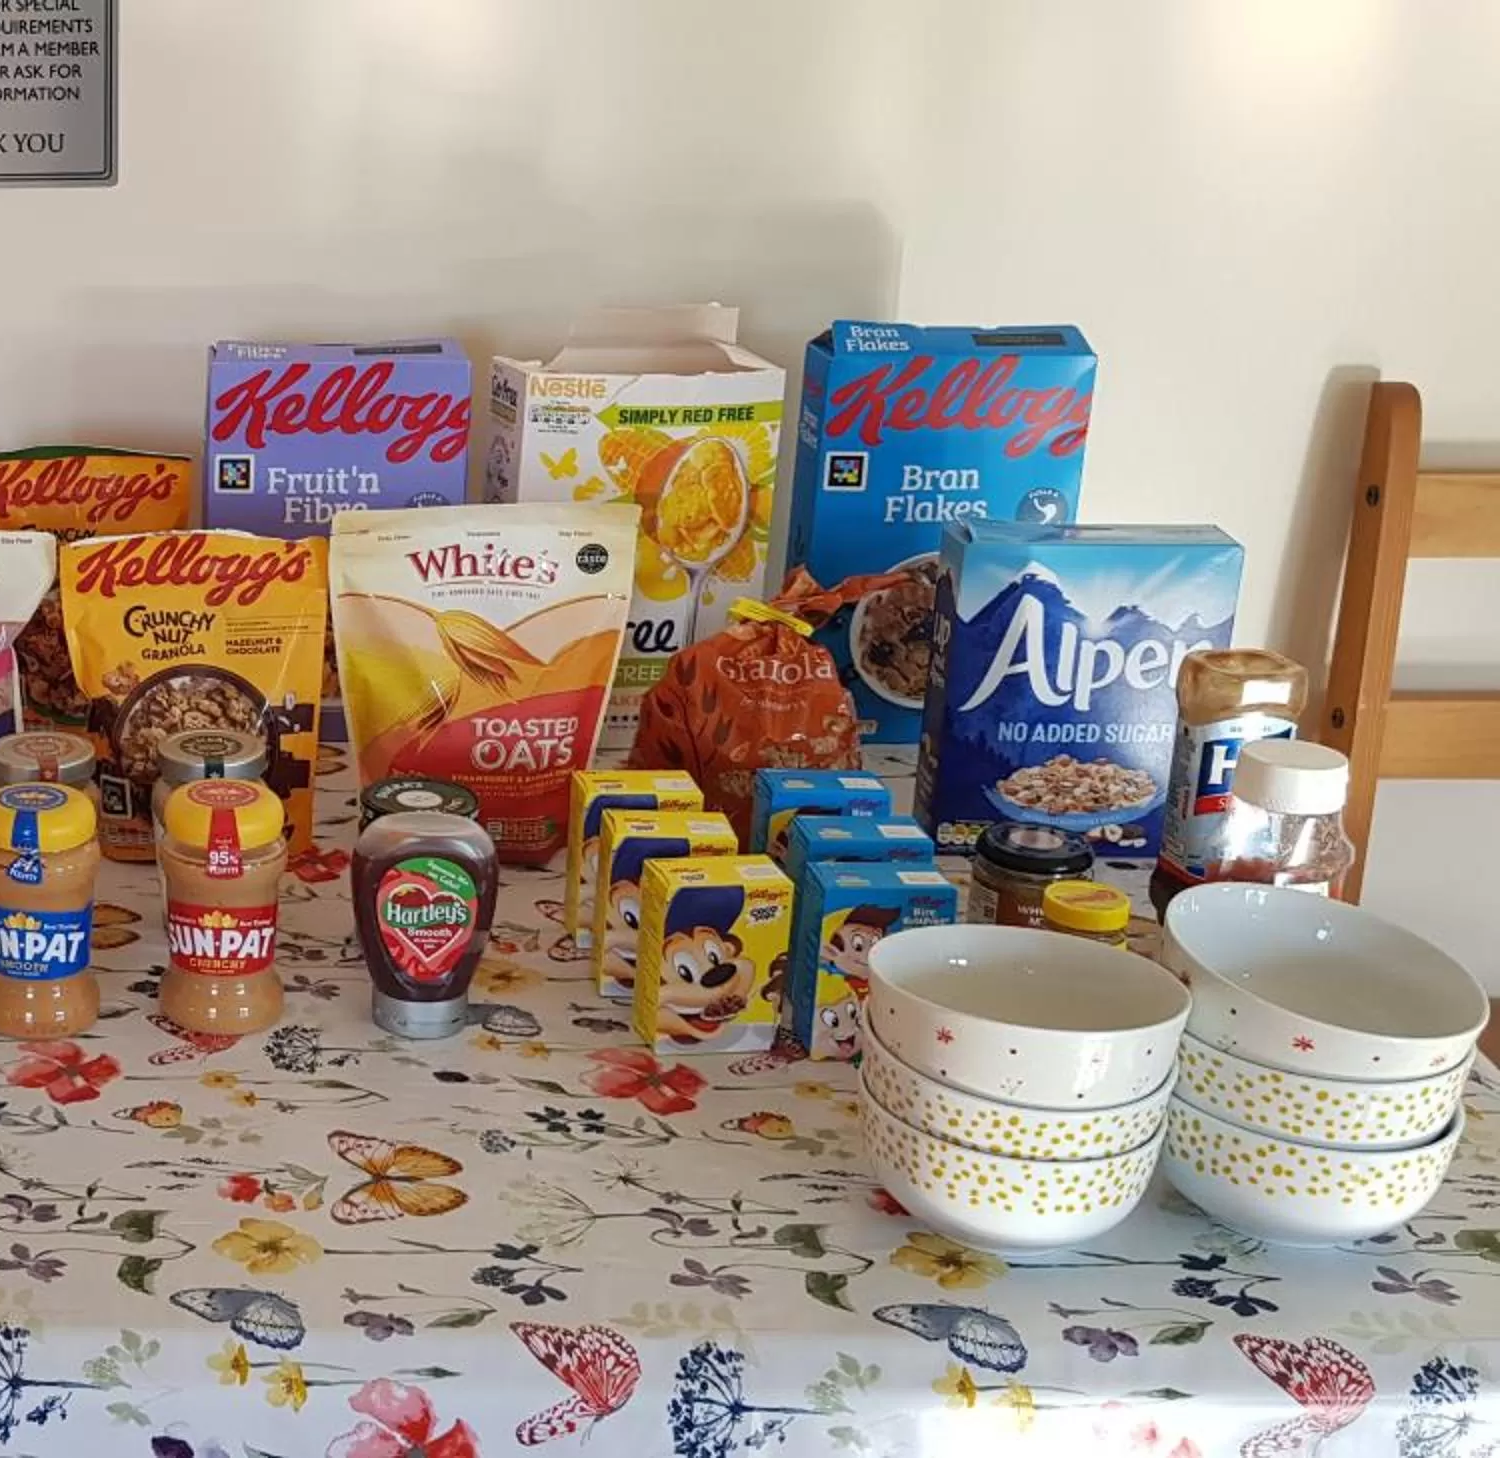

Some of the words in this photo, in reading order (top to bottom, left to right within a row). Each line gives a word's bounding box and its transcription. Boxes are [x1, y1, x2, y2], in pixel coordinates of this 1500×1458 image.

[14, 0, 80, 12] SPECIAL
[18, 42, 30, 56] A
[35, 41, 100, 57] MEMBER
[13, 65, 44, 79] ASK
[49, 64, 83, 79] FOR
[13, 132, 65, 154] YOU
[850, 325, 900, 338] Bran
[846, 338, 910, 352] Flakes
[618, 408, 675, 426] SIMPLY
[682, 408, 713, 424] RED
[718, 406, 754, 422] FREE
[267, 466, 381, 495] Fruit'n
[901, 465, 980, 491] Bran
[884, 496, 988, 523] Flakes
[74, 534, 312, 607] Kellogg's
[405, 543, 559, 584] White's
[124, 605, 216, 637] CRUNCHY
[153, 629, 194, 645] NUT
[225, 637, 275, 647] HAZELNUT
[141, 643, 206, 661] GRANOLA
[225, 646, 281, 656] CHOCOLATE
[471, 717, 579, 737] TOASTED
[998, 722, 1030, 742] NO
[1033, 722, 1100, 743] ADDED
[1103, 723, 1174, 744] SUGAR
[471, 737, 573, 771] OATS
[387, 901, 467, 925] Hartley's
[407, 926, 453, 937] Smooth
[189, 958, 247, 969] CRUNCHY
